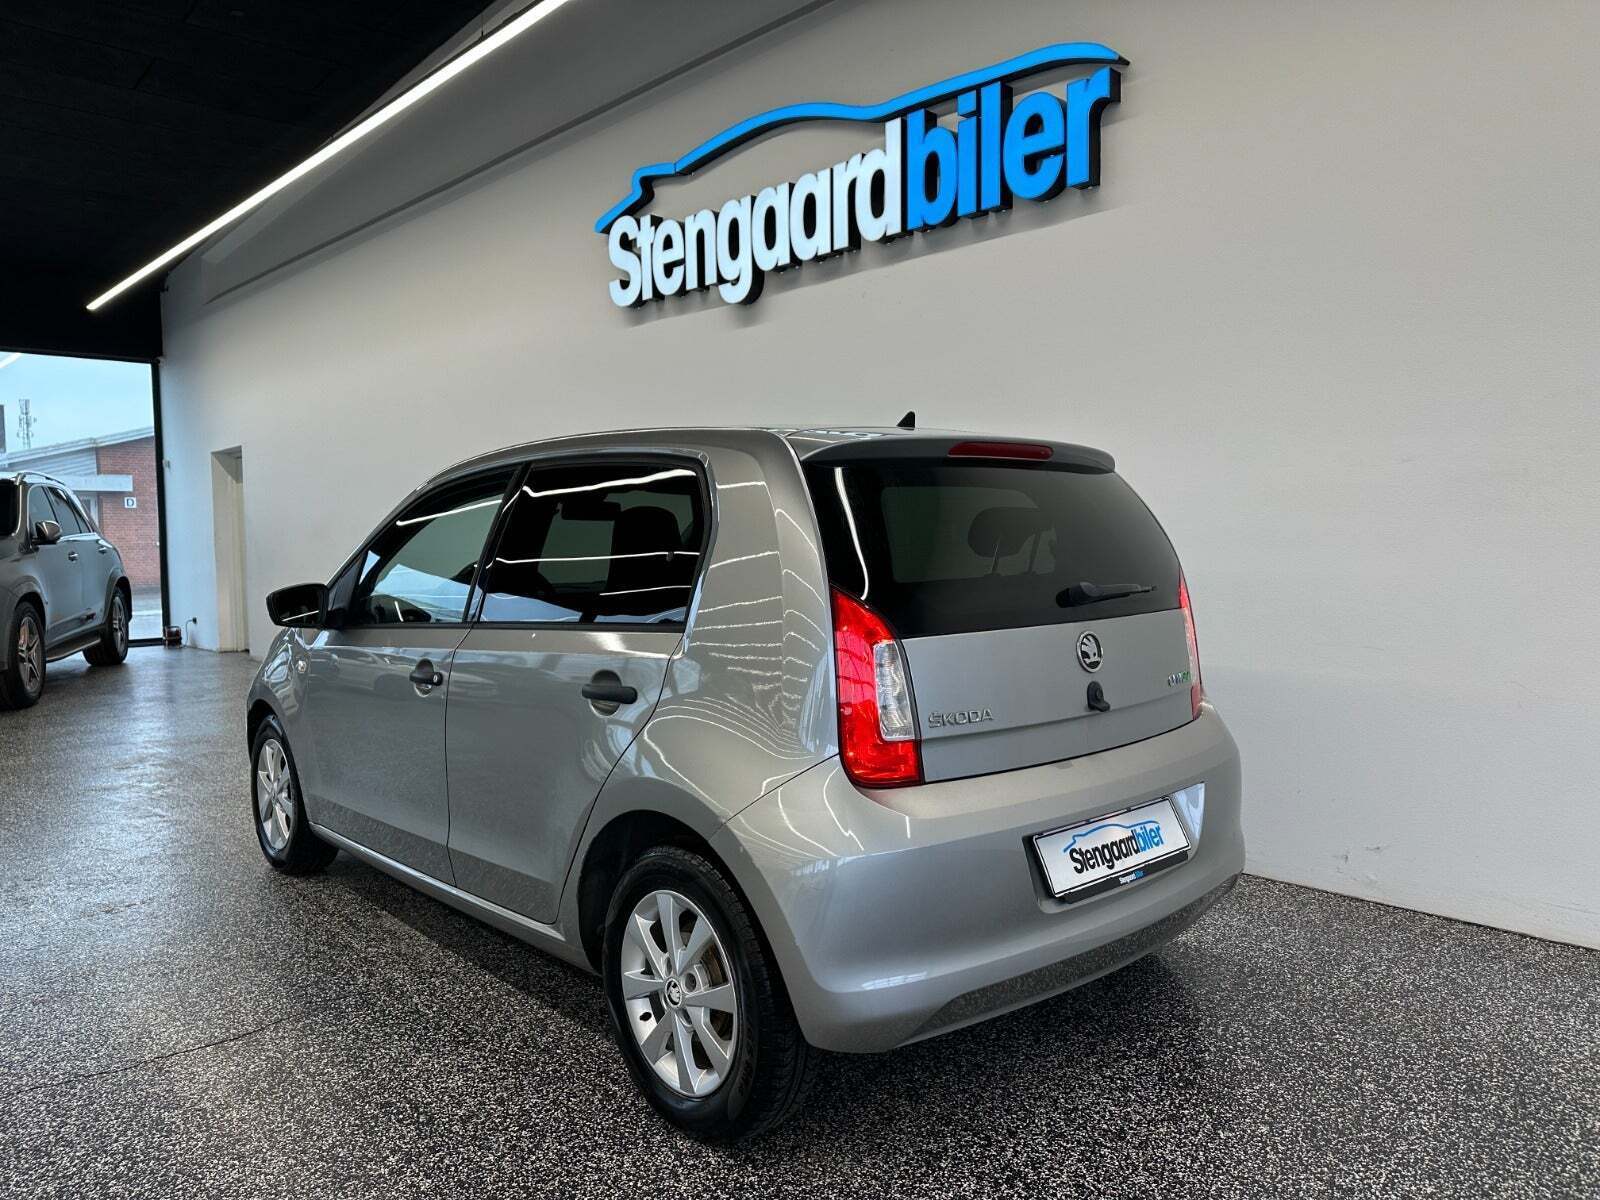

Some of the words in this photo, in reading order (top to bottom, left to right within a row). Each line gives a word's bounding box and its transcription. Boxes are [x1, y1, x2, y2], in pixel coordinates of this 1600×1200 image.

[608, 66, 1117, 308] Stengaardbiler
[928, 708, 993, 728] ŠKODA
[1069, 824, 1164, 874] Stengaardbiler
